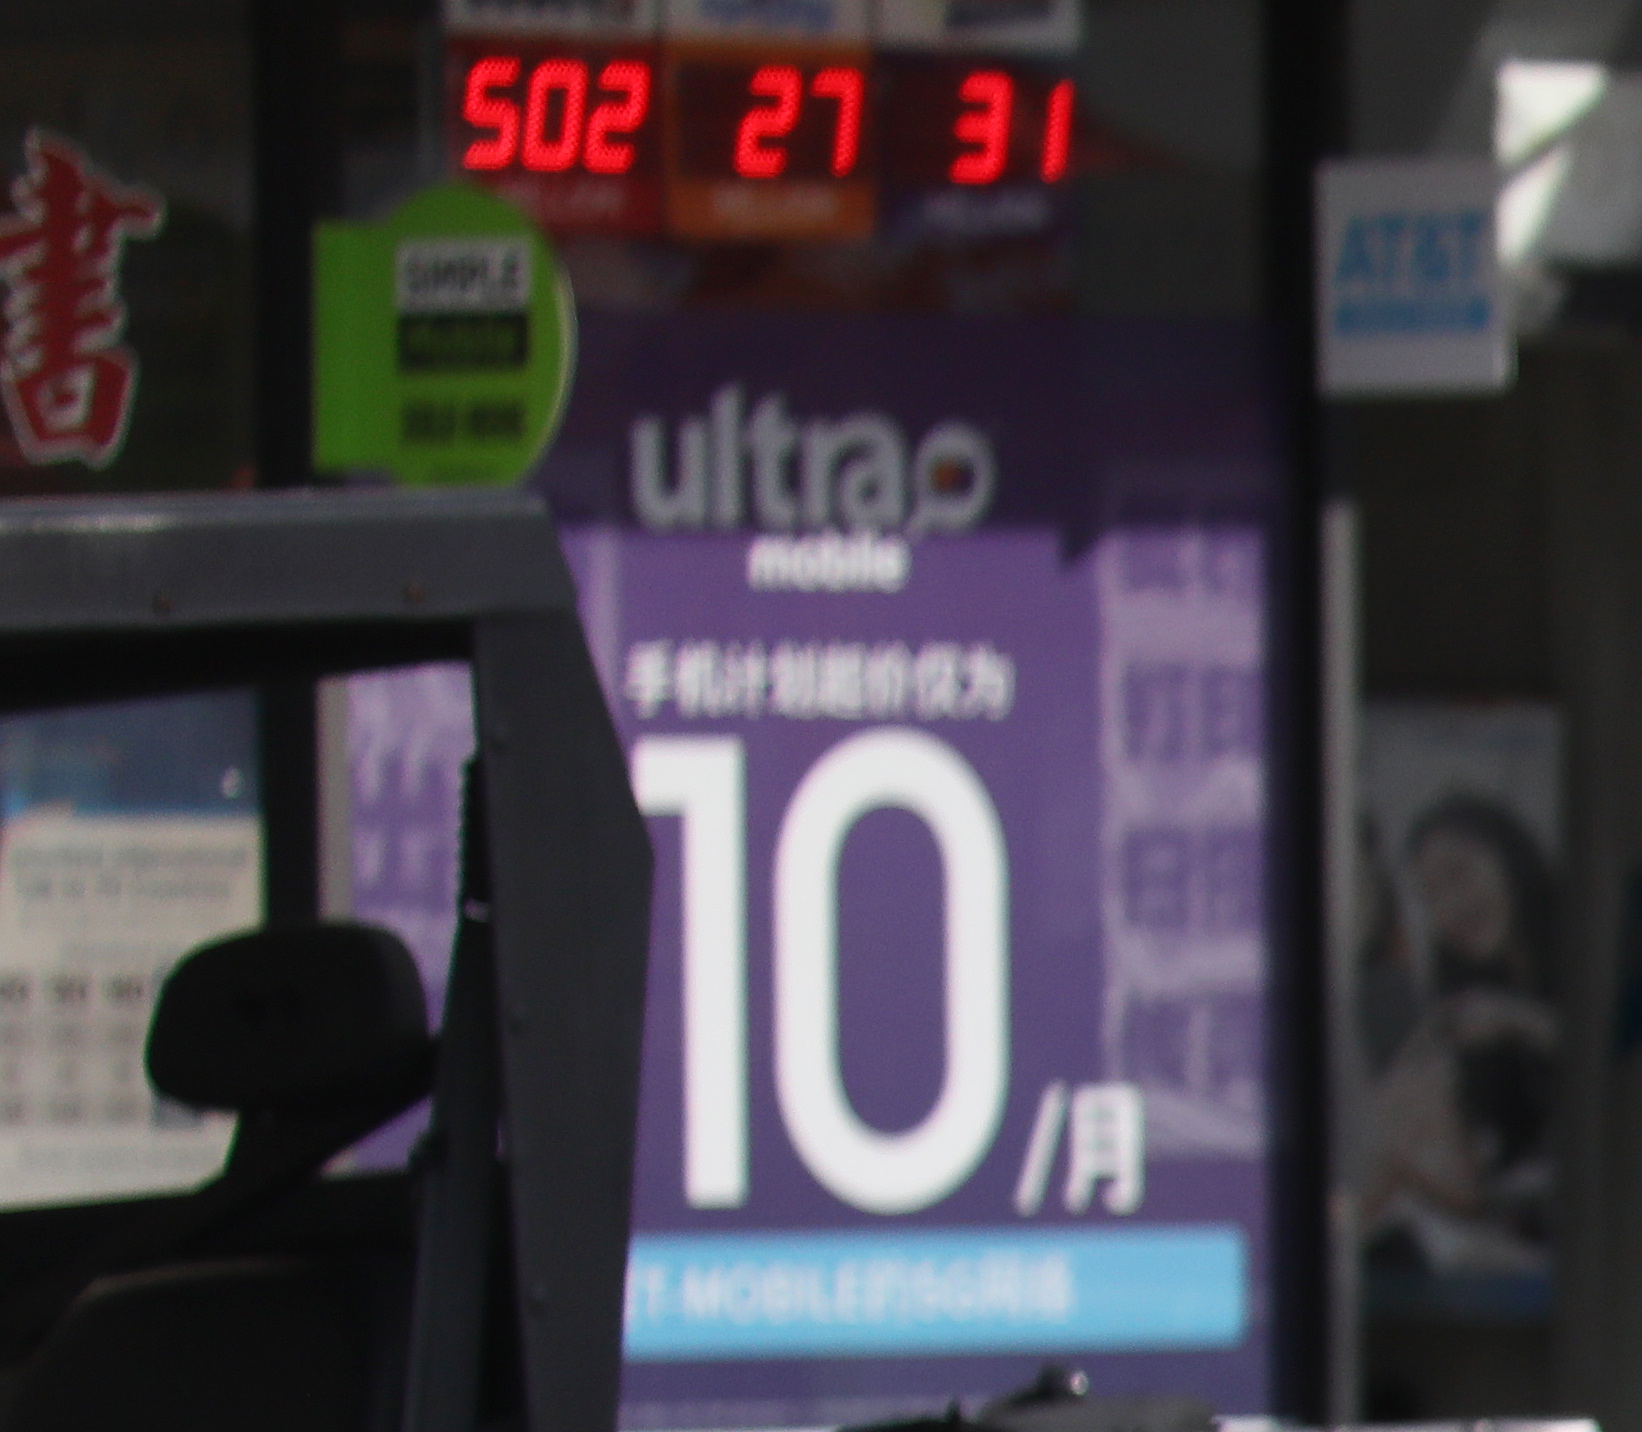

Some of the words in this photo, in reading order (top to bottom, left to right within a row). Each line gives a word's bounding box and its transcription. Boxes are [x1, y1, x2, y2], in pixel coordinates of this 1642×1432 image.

[462, 56, 651, 174] 502
[733, 65, 864, 178] 27
[949, 70, 1075, 184] 31
